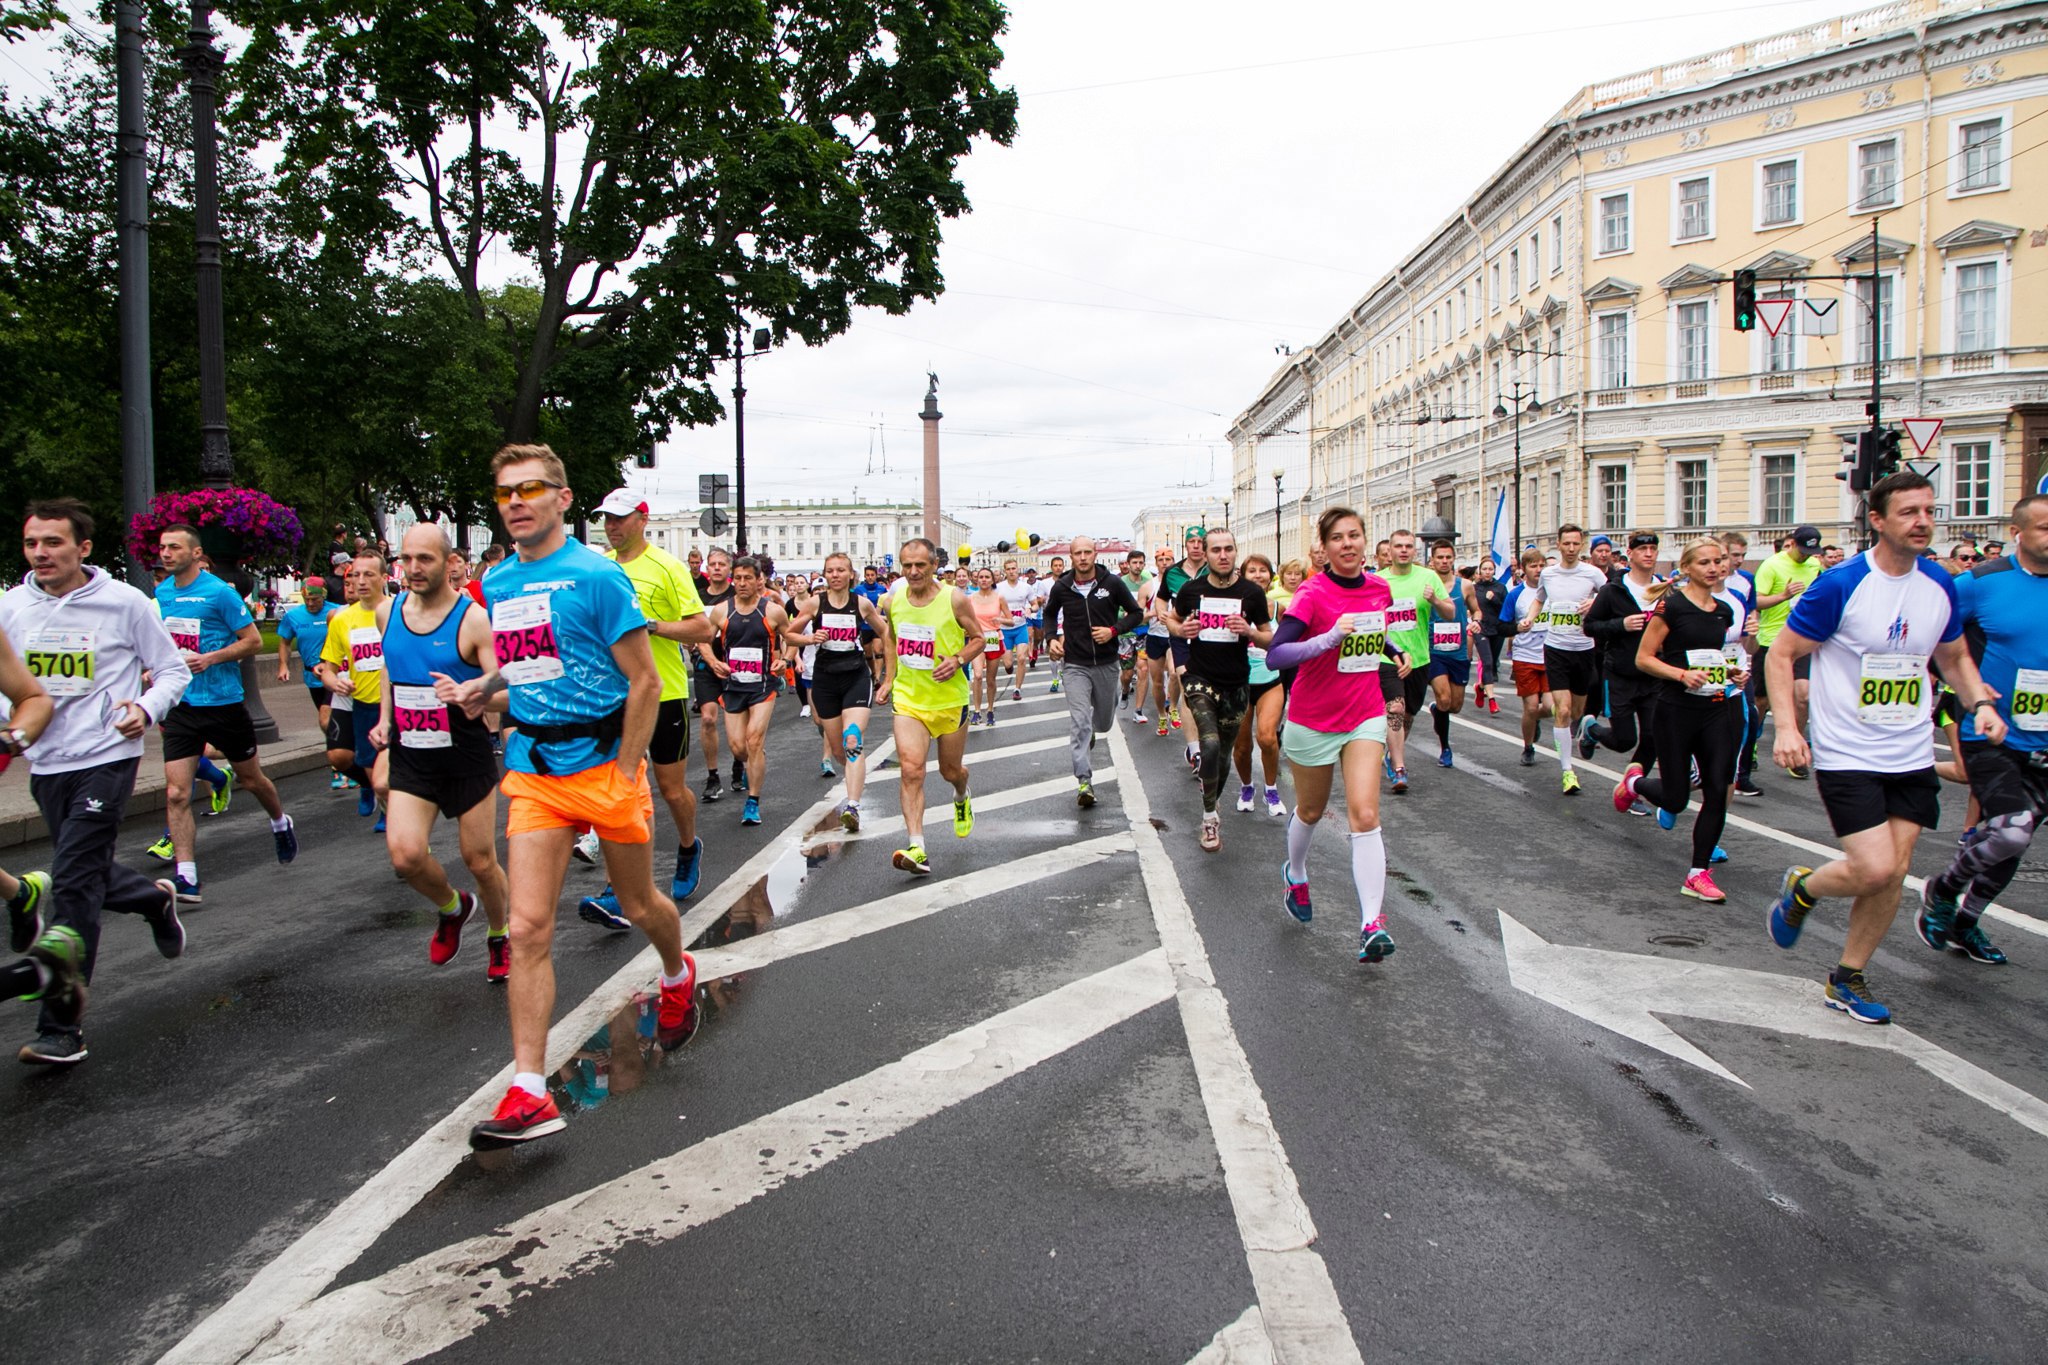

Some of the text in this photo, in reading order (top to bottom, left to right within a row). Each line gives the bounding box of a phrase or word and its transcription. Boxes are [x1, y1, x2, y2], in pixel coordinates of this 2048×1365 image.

[1387, 609, 1417, 624] 3165
[1552, 613, 1580, 626] 7793
[495, 625, 556, 663] 3254
[898, 638, 934, 658] 1540
[1342, 633, 1384, 657] 8669
[1436, 633, 1460, 644] 1267
[28, 653, 89, 678] 5701
[735, 661, 757, 673] 473
[1861, 680, 1920, 705] 8070
[2014, 692, 2048, 715] 89
[402, 709, 440, 731] 325
